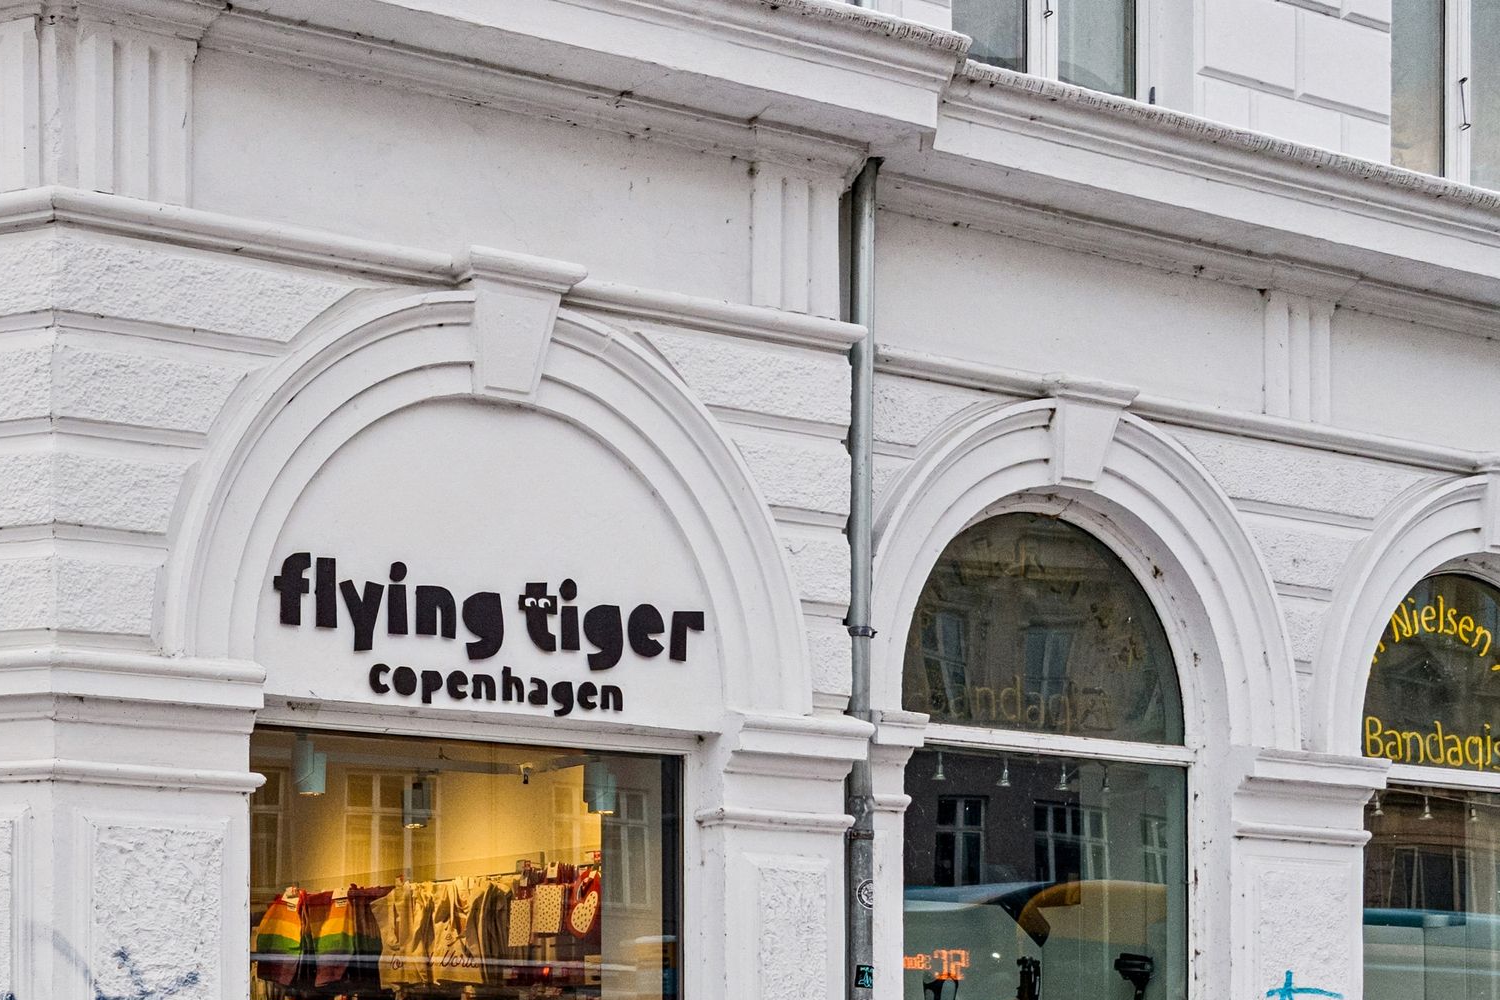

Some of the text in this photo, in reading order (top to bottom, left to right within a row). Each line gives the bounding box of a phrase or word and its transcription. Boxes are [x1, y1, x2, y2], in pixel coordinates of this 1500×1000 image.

[273, 551, 705, 671] flying tiger
[1391, 595, 1493, 657] Nielsen
[368, 662, 624, 717] copenhagen
